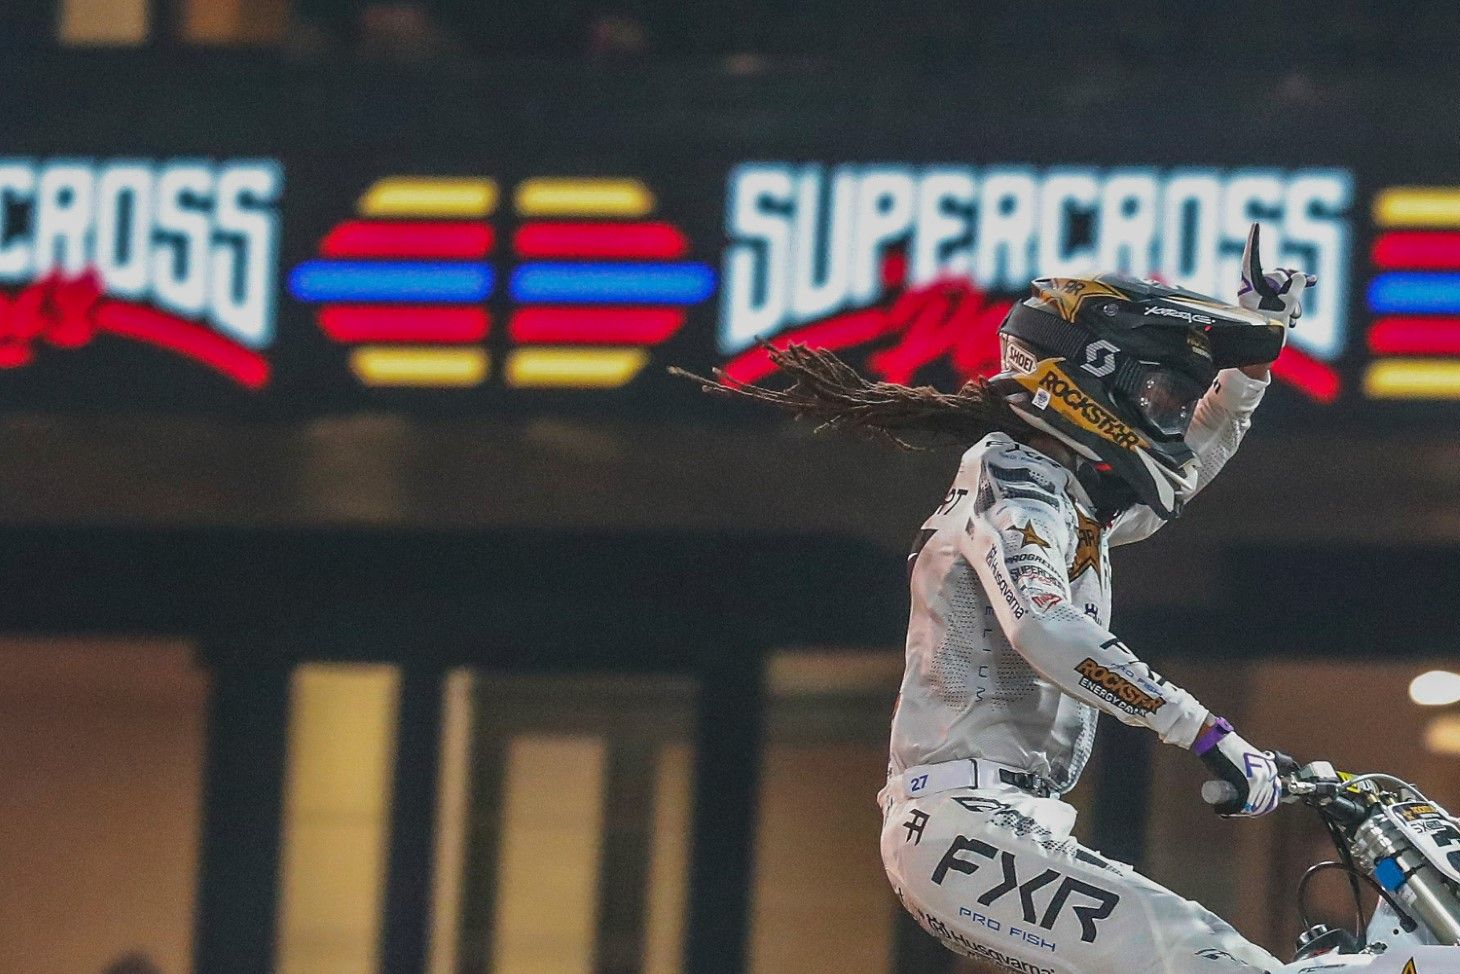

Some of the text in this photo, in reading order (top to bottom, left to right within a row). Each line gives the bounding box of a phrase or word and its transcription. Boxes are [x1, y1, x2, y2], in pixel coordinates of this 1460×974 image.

[719, 164, 1354, 356] SUPERCROSS
[1008, 343, 1035, 373] SHOEI
[1038, 370, 1141, 450] ROCKSTAR
[1080, 677, 1120, 706] ENERGY
[910, 774, 929, 792] 27
[931, 834, 1121, 944] FXR
[959, 906, 1056, 952] PRO FISH
